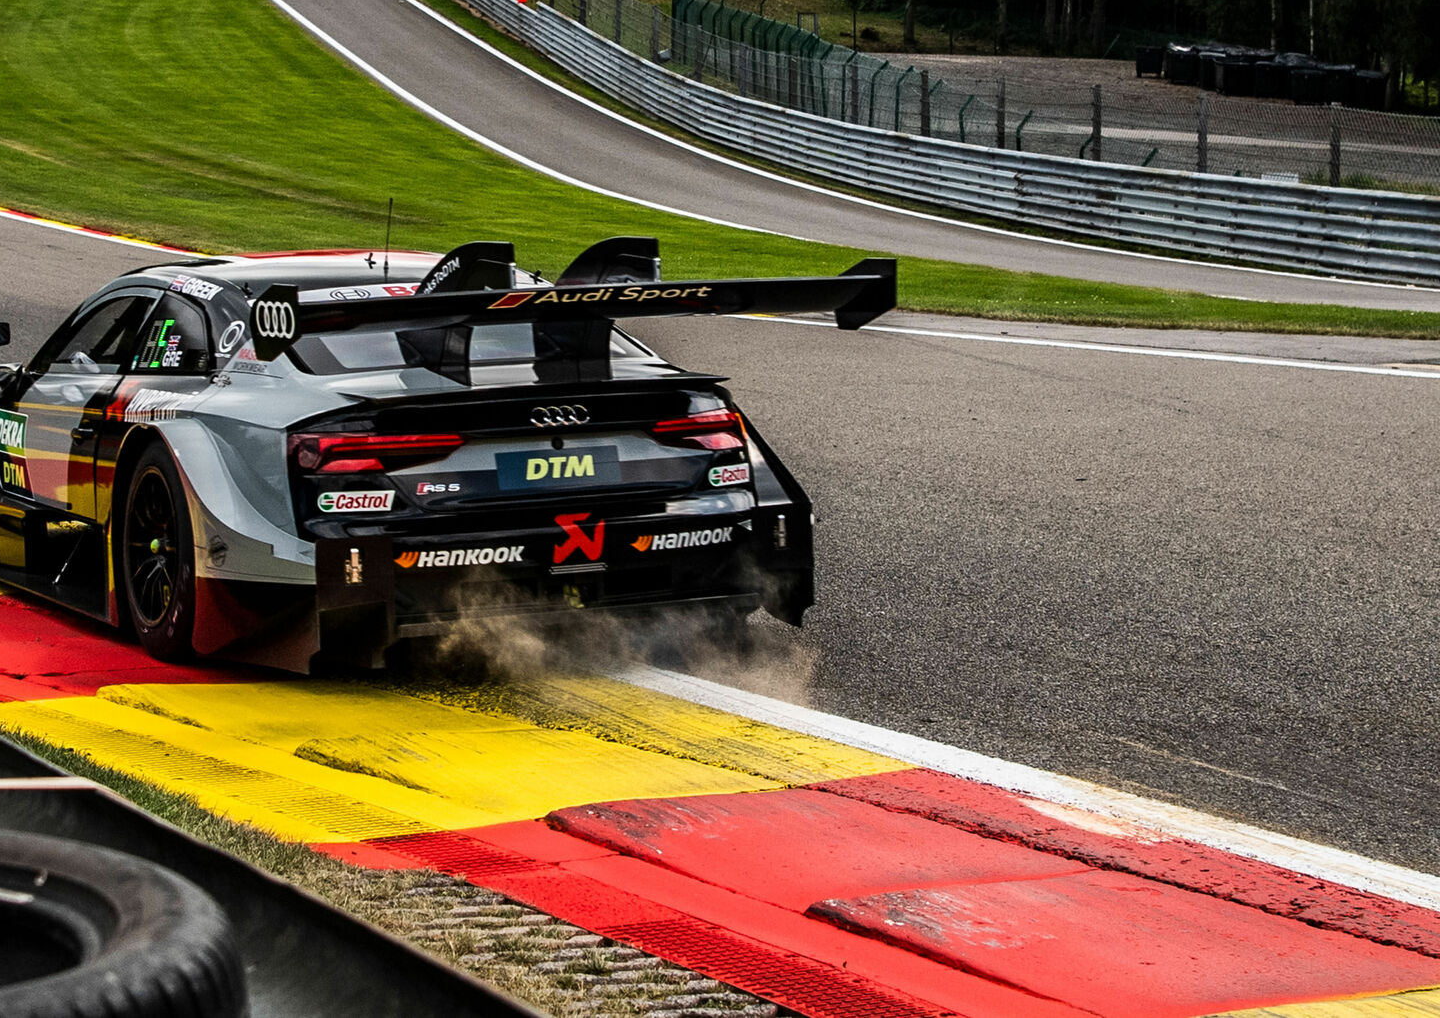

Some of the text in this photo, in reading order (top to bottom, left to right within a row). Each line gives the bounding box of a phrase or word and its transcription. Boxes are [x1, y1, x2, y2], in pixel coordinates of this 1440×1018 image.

[181, 278, 224, 301] GREEN
[533, 286, 712, 303] Audi Sport
[162, 350, 183, 367] GRE
[3, 461, 26, 489] DTM
[526, 454, 596, 481] DTM
[419, 483, 461, 493] RS 5
[335, 493, 389, 510] Castrol
